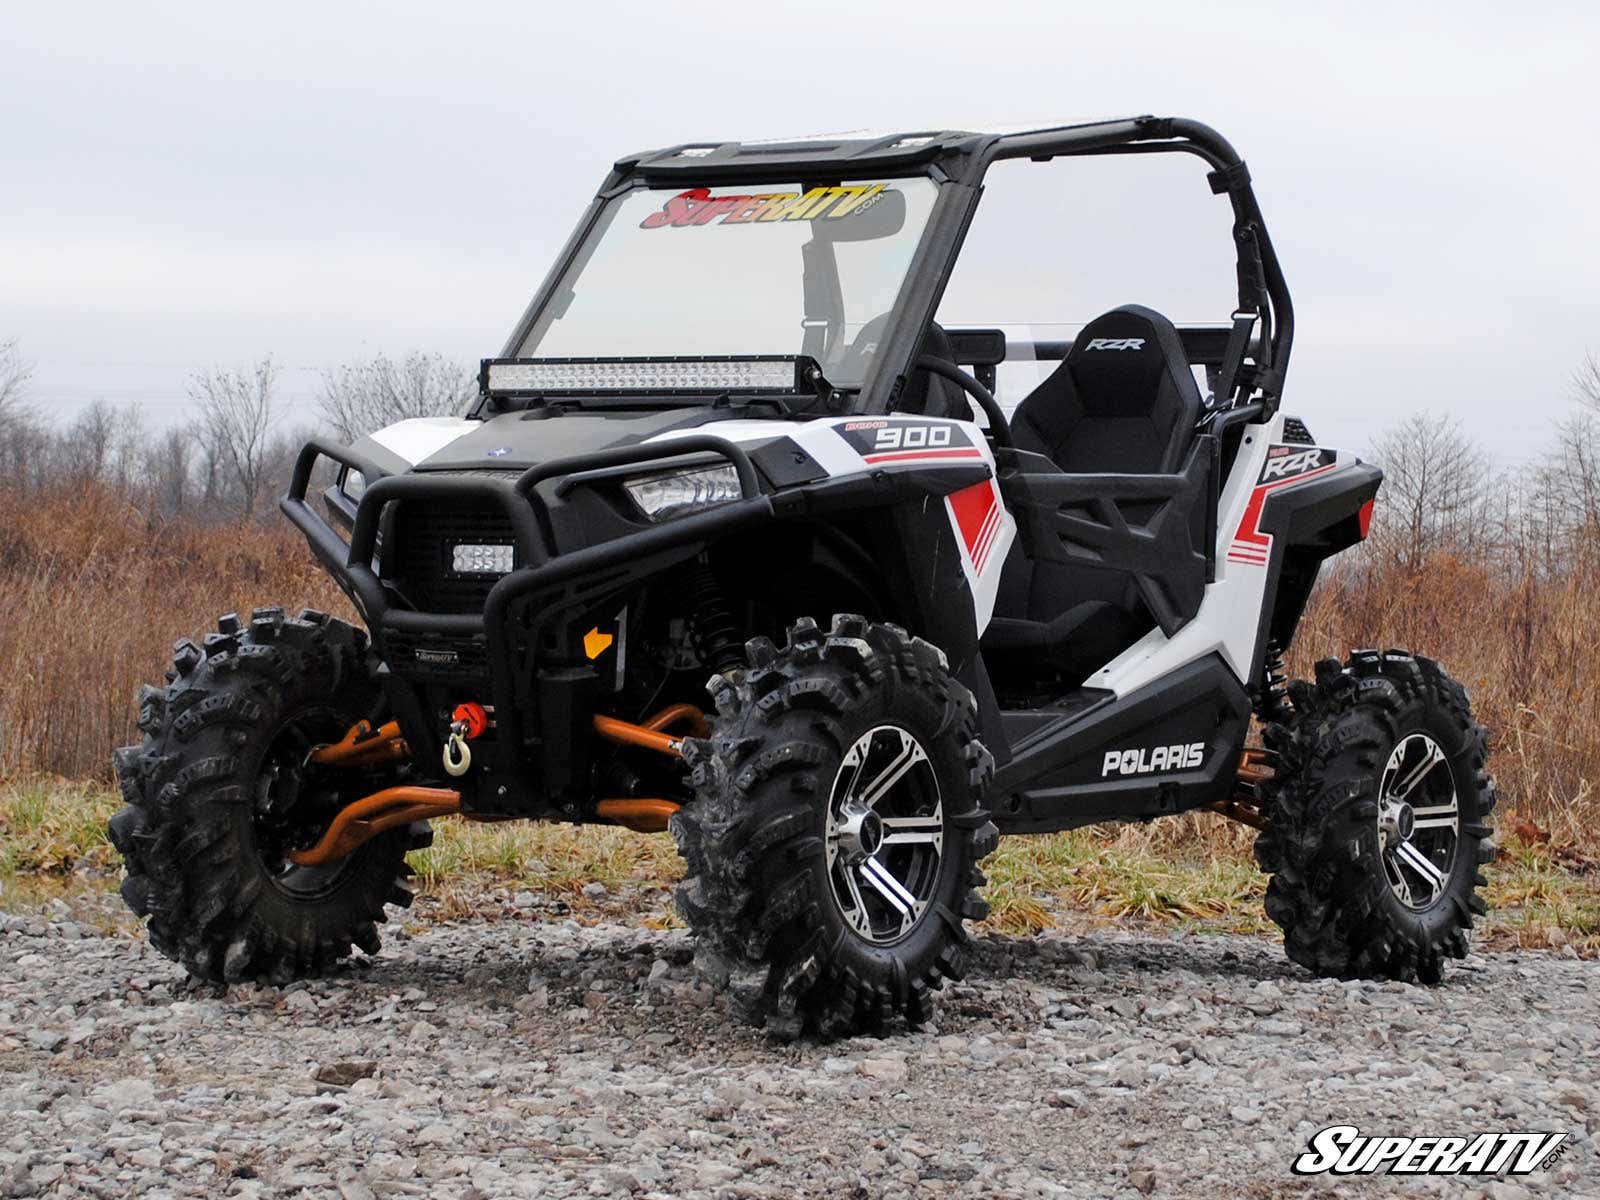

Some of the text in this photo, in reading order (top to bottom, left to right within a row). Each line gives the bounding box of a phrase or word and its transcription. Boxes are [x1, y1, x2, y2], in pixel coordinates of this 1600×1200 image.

[639, 185, 885, 229] SUPERATV
[1085, 338, 1146, 351] RZR
[874, 426, 951, 449] 900
[1262, 449, 1322, 481] RZR
[1102, 742, 1205, 777] POLARIS
